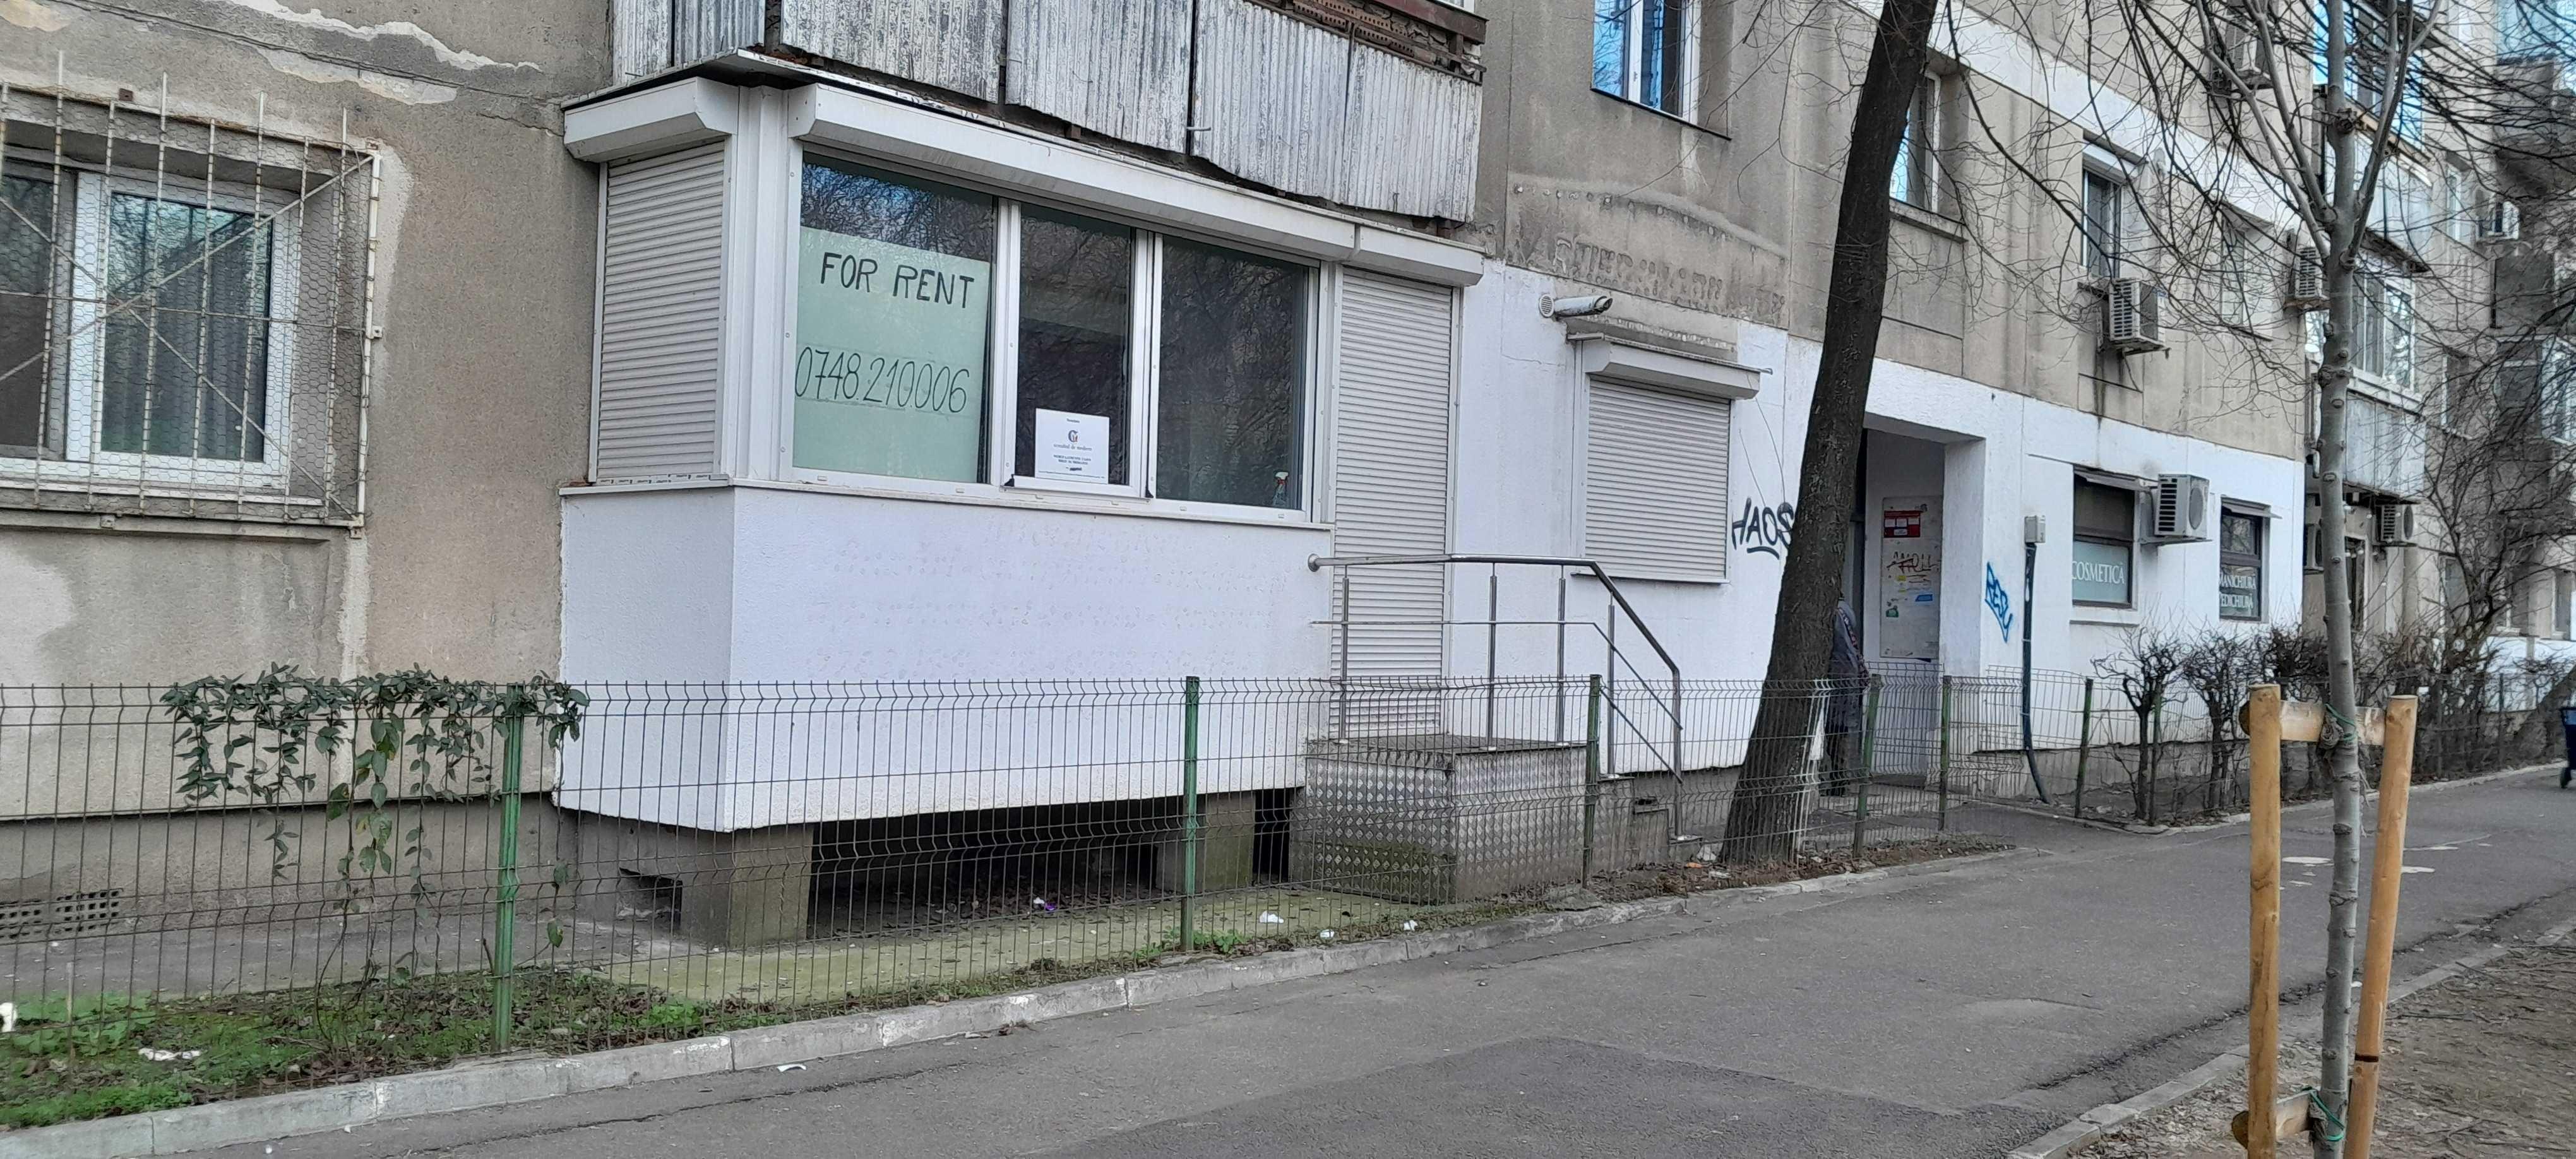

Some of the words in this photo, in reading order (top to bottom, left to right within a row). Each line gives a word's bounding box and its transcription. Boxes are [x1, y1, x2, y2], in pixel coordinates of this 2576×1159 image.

[820, 252, 878, 293] FOR
[892, 264, 975, 309] RENT
[794, 347, 970, 413] 0748.210.006
